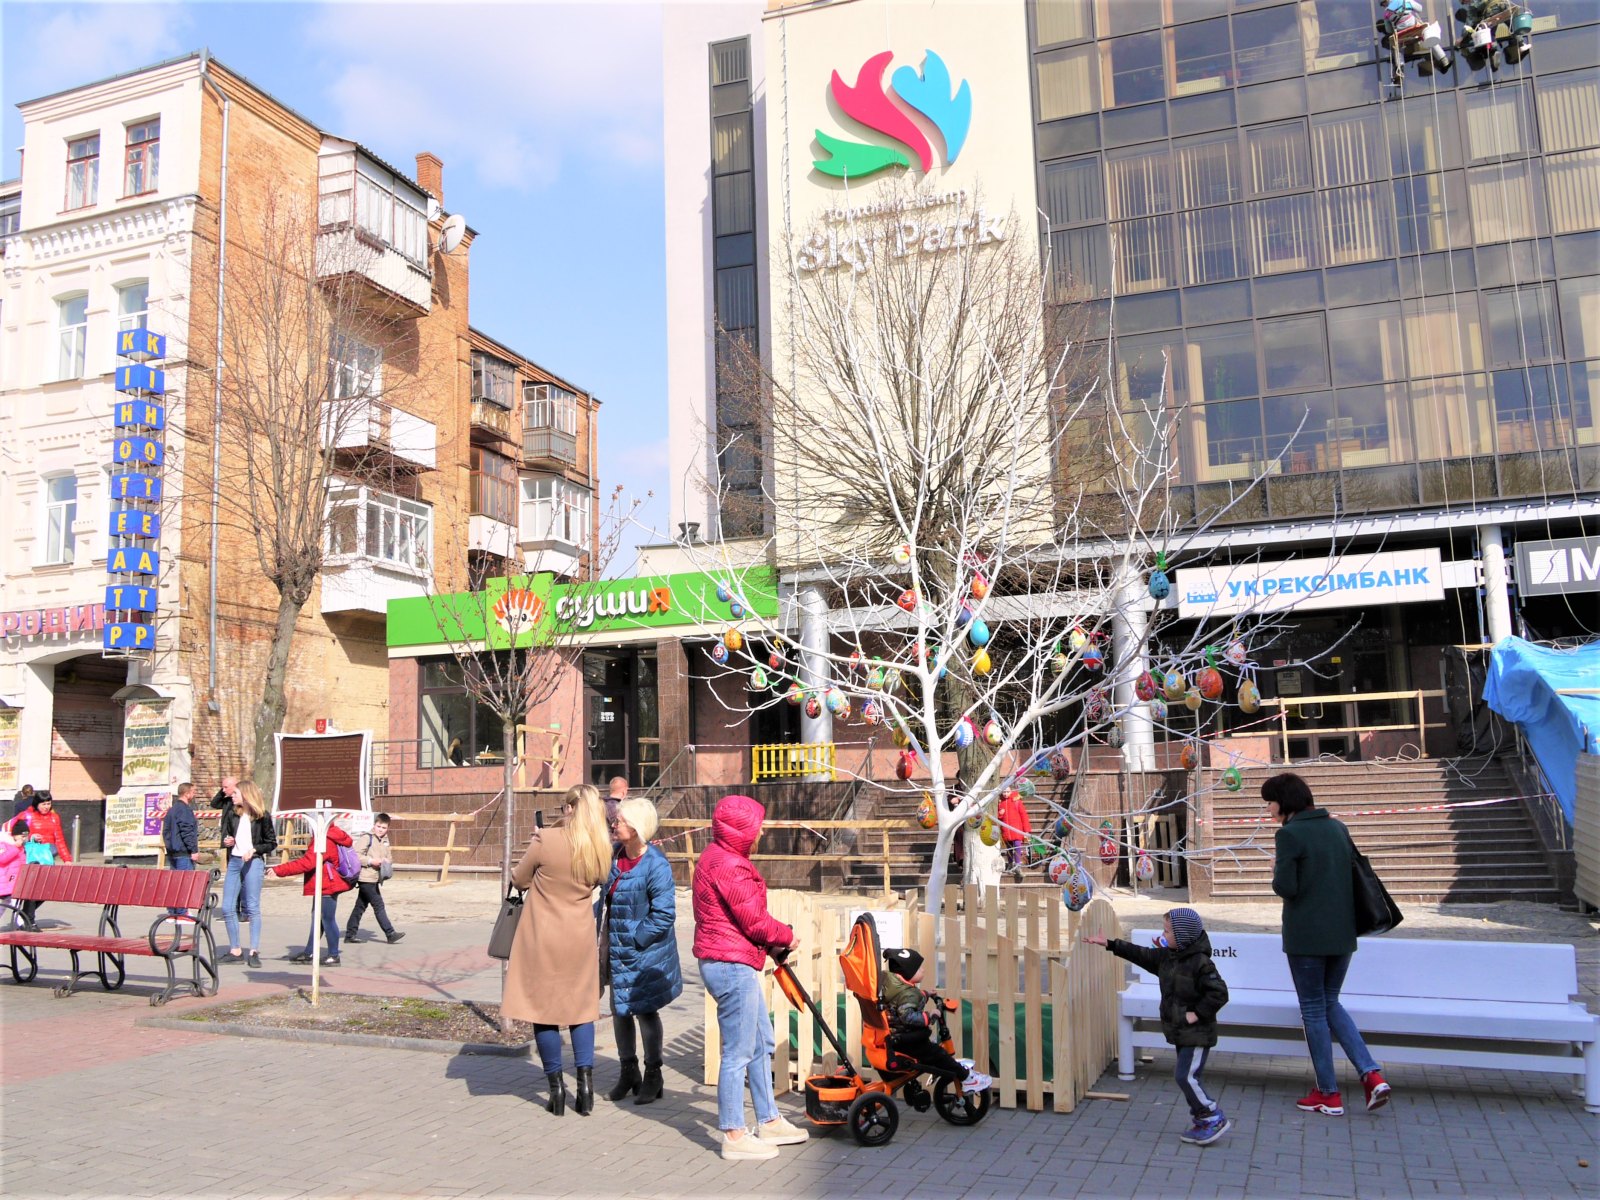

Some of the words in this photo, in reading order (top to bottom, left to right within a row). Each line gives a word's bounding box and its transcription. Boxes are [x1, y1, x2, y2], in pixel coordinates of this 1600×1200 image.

[799, 226, 877, 273] Sky
[893, 207, 1004, 258] Park
[110, 332, 134, 645] КІНОТЕАТР
[135, 334, 159, 645] КІНОТЕАТР
[1228, 567, 1430, 597] УКРЕКСІМБАНК
[123, 757, 165, 776] ТРАНЗИТ
[1213, 946, 1237, 958] ark
